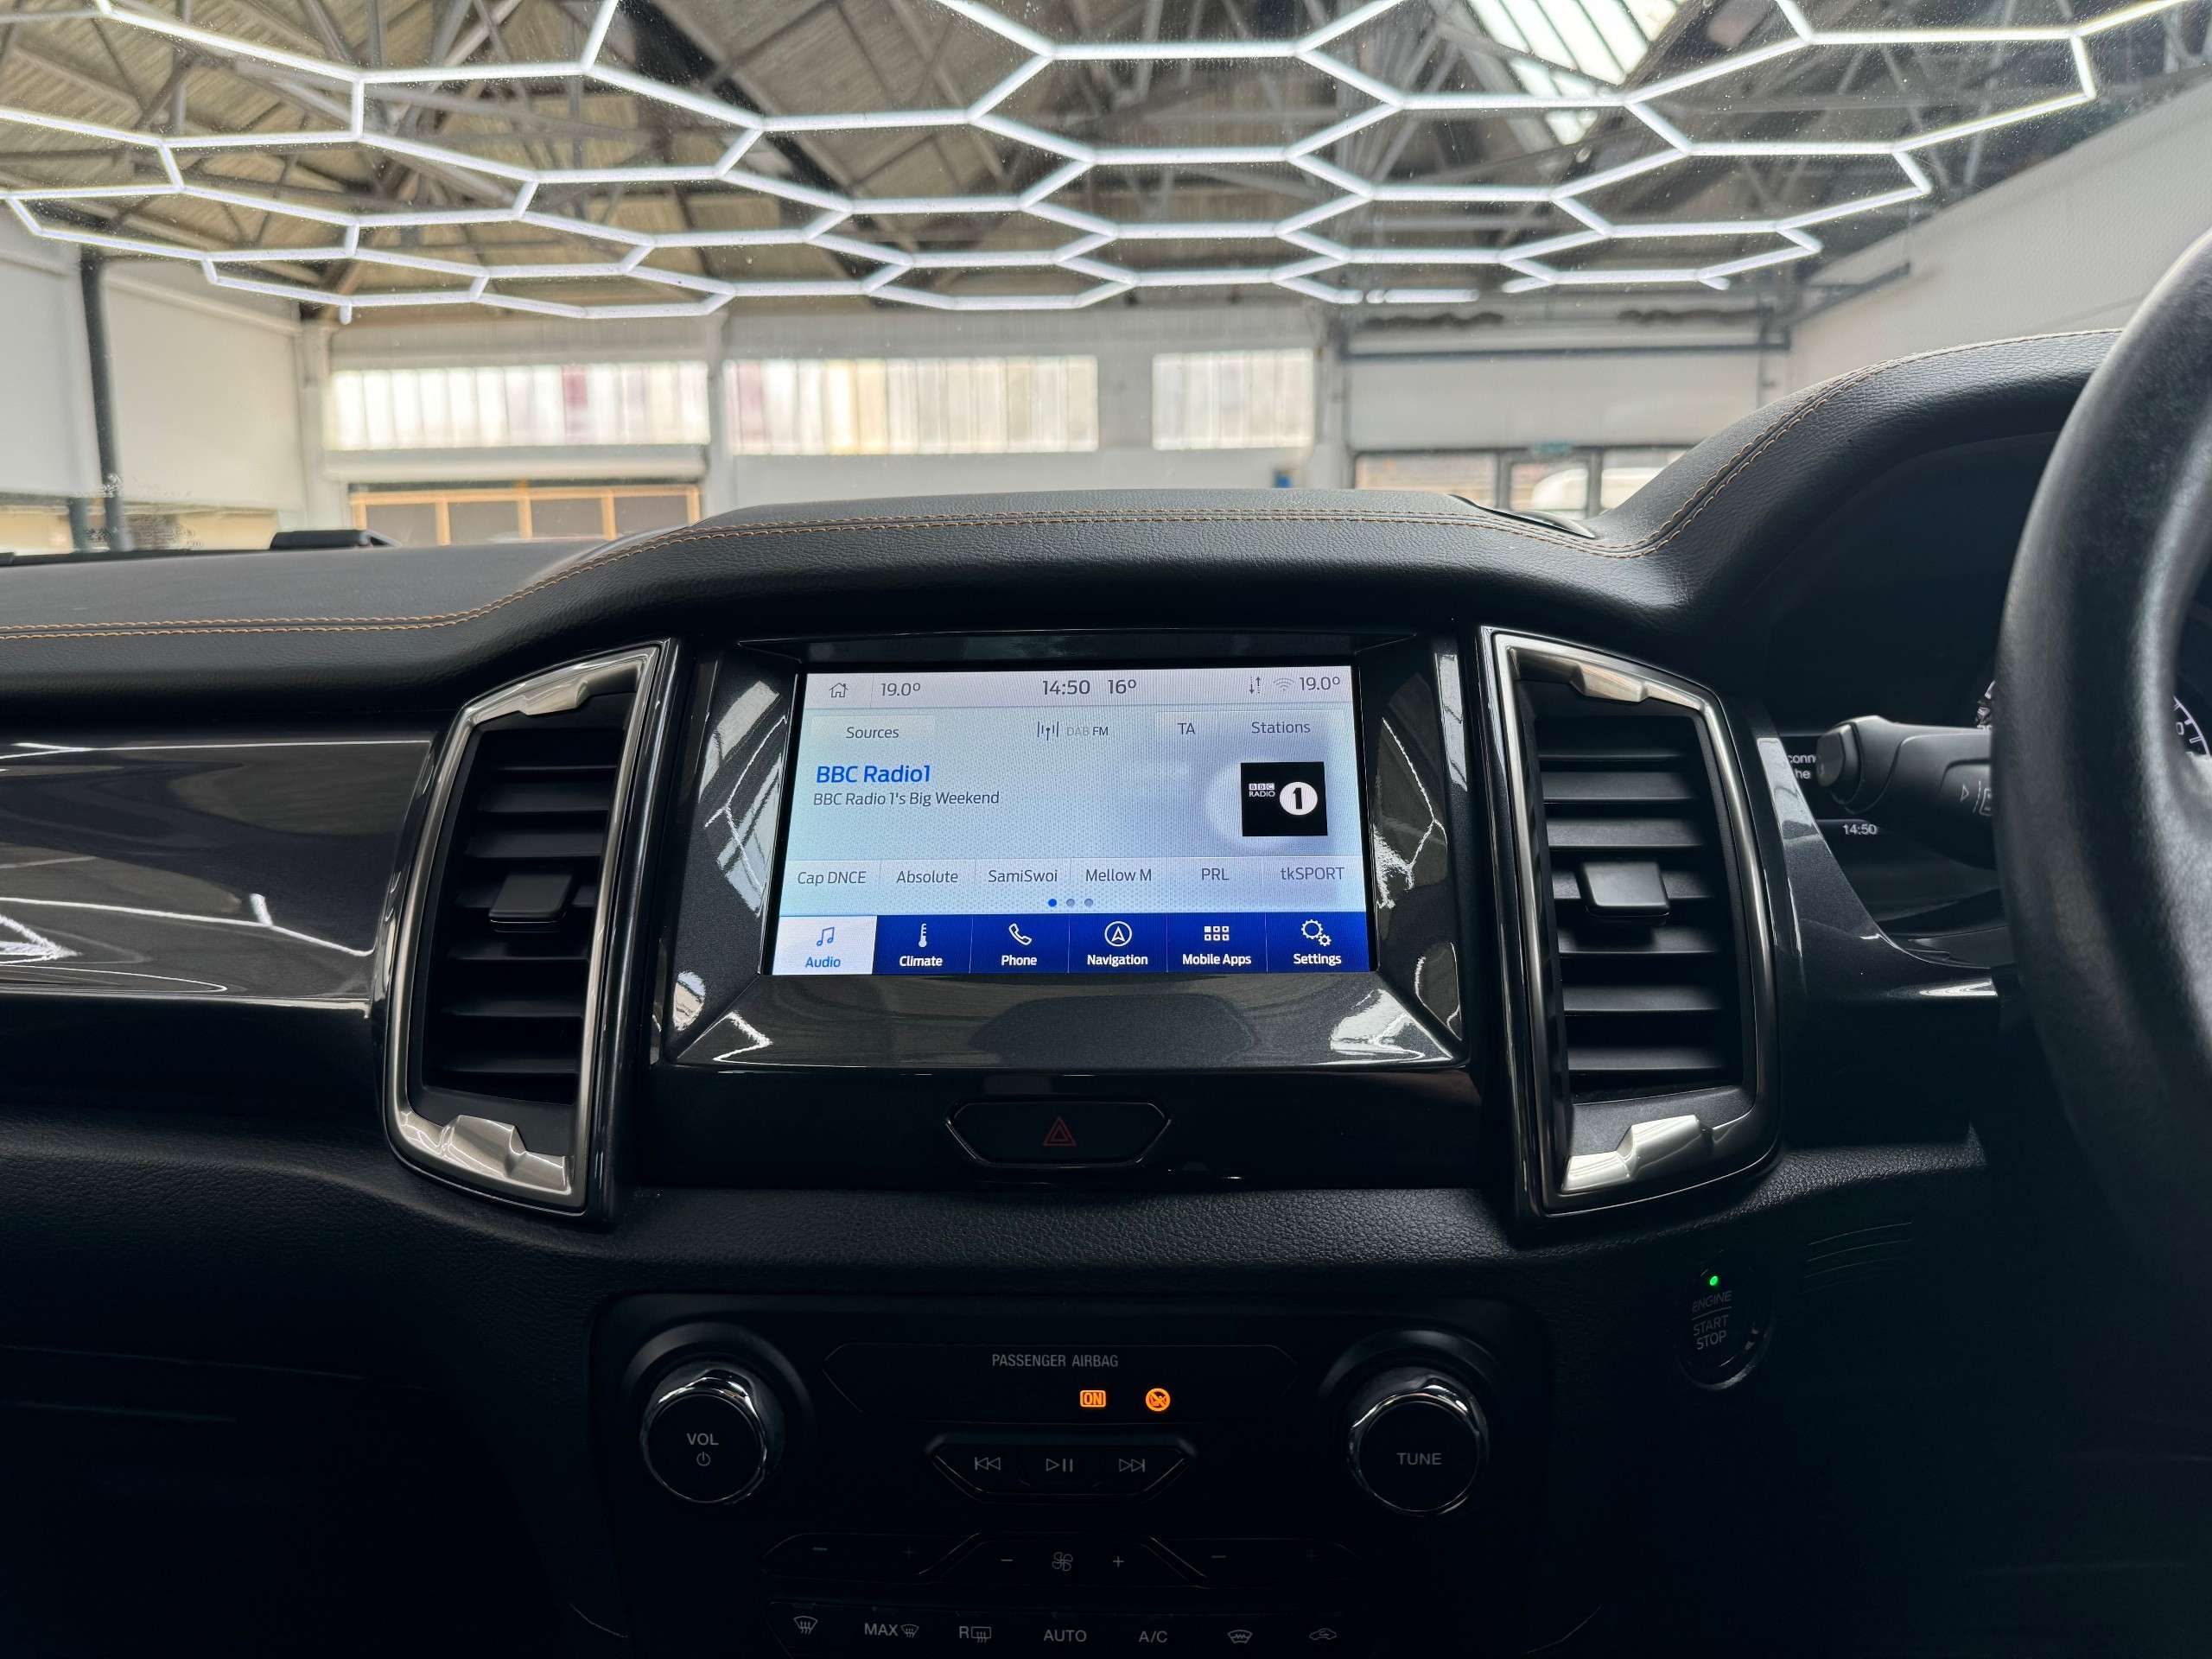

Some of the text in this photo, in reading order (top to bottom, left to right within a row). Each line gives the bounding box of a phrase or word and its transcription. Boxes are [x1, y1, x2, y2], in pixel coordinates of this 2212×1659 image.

[1042, 680, 1090, 695] 14:50
[846, 727, 899, 740] Sources
[1066, 726, 1109, 736] DAB FM
[1178, 722, 1196, 735] TA
[1251, 721, 1312, 734] Stations
[816, 765, 931, 783] BBC Radio1
[813, 791, 1001, 807] BBC Radio 1's Big Weekend
[1292, 787, 1303, 810] 1
[1842, 823, 1879, 836] 14:50
[798, 871, 867, 887] Cap DNCE
[896, 870, 959, 883] Absolute
[988, 869, 1058, 883] SamiSwoi
[1085, 869, 1153, 882] Mellow M
[1201, 868, 1230, 881] PRL
[1281, 867, 1345, 880] tkSPORT
[805, 956, 842, 969] Audio
[899, 955, 944, 967] Climate
[1001, 955, 1038, 966] Phone
[1086, 954, 1148, 968] Navigation
[1182, 954, 1252, 968] Mobile Apps
[1293, 953, 1342, 966] Settings
[1692, 1290, 1732, 1313] ENGINE
[1694, 1314, 1729, 1336] START
[1696, 1331, 1727, 1350] STOP
[991, 1354, 1119, 1368] PASSENGER AIRBAG
[1083, 1392, 1103, 1406] ON
[686, 1433, 719, 1446] VOL
[1396, 1452, 1442, 1465] TUNE
[864, 1623, 899, 1637] MAX
[959, 1626, 969, 1639] R
[1043, 1629, 1087, 1643] AUTO
[1139, 1630, 1168, 1644] A/C
